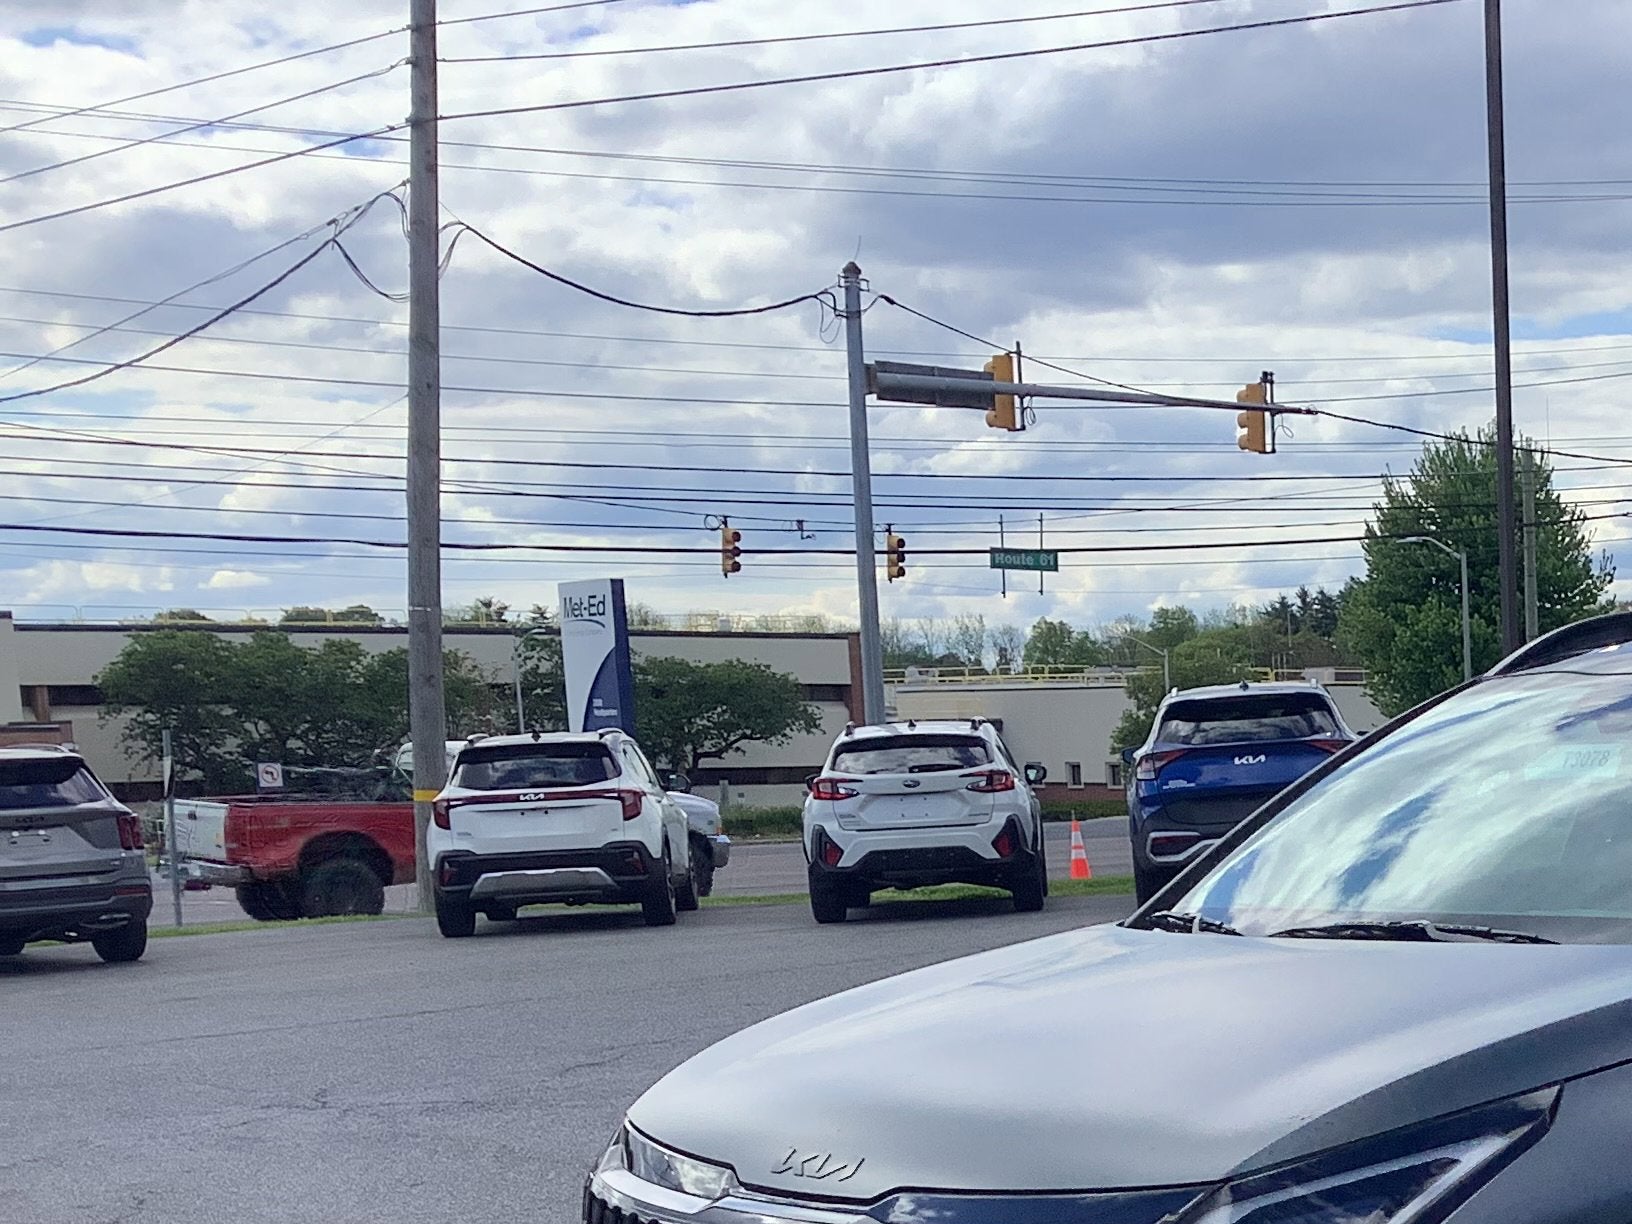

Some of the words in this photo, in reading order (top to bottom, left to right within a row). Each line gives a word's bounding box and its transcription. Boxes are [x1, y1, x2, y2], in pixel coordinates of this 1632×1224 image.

[995, 552, 1034, 566] Route
[1040, 553, 1055, 566] 61
[563, 594, 606, 618] Met-Ed
[1233, 754, 1266, 765] KIA
[770, 1147, 866, 1182] KIA
